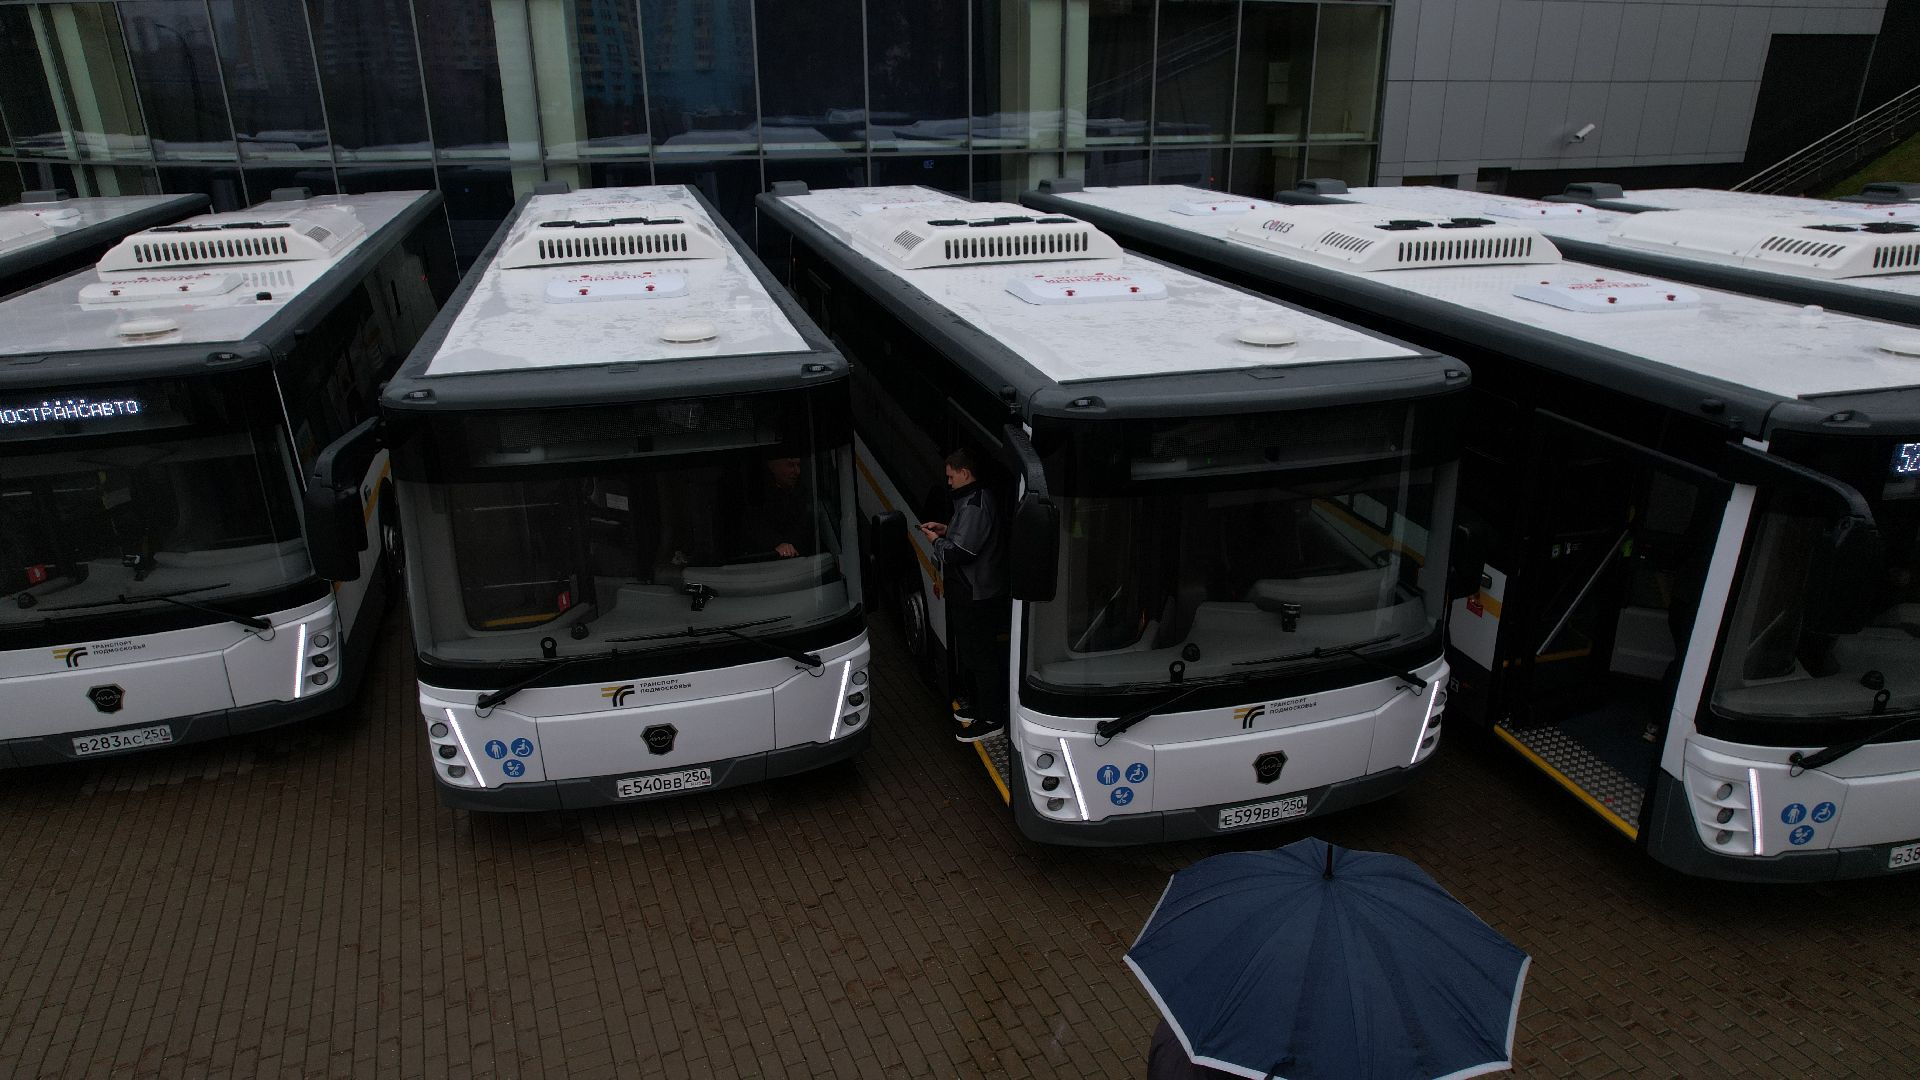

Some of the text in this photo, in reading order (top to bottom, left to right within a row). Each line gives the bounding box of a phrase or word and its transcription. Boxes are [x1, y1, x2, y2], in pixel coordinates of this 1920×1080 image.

[92, 641, 132, 650] ТРАНСПОРТ
[93, 644, 146, 655] ПОДМОСКОВЬЯ
[640, 684, 691, 693] ПОДМОСКОВЬЯ
[1270, 698, 1306, 707] ТРАНСПОРТ
[1270, 702, 1316, 714] ПОДМОСКОВЬЯ
[79, 728, 168, 753] В283АС 250
[623, 770, 708, 795] Е540ВВ 250
[1224, 798, 1304, 826] Е599ВВ 250
